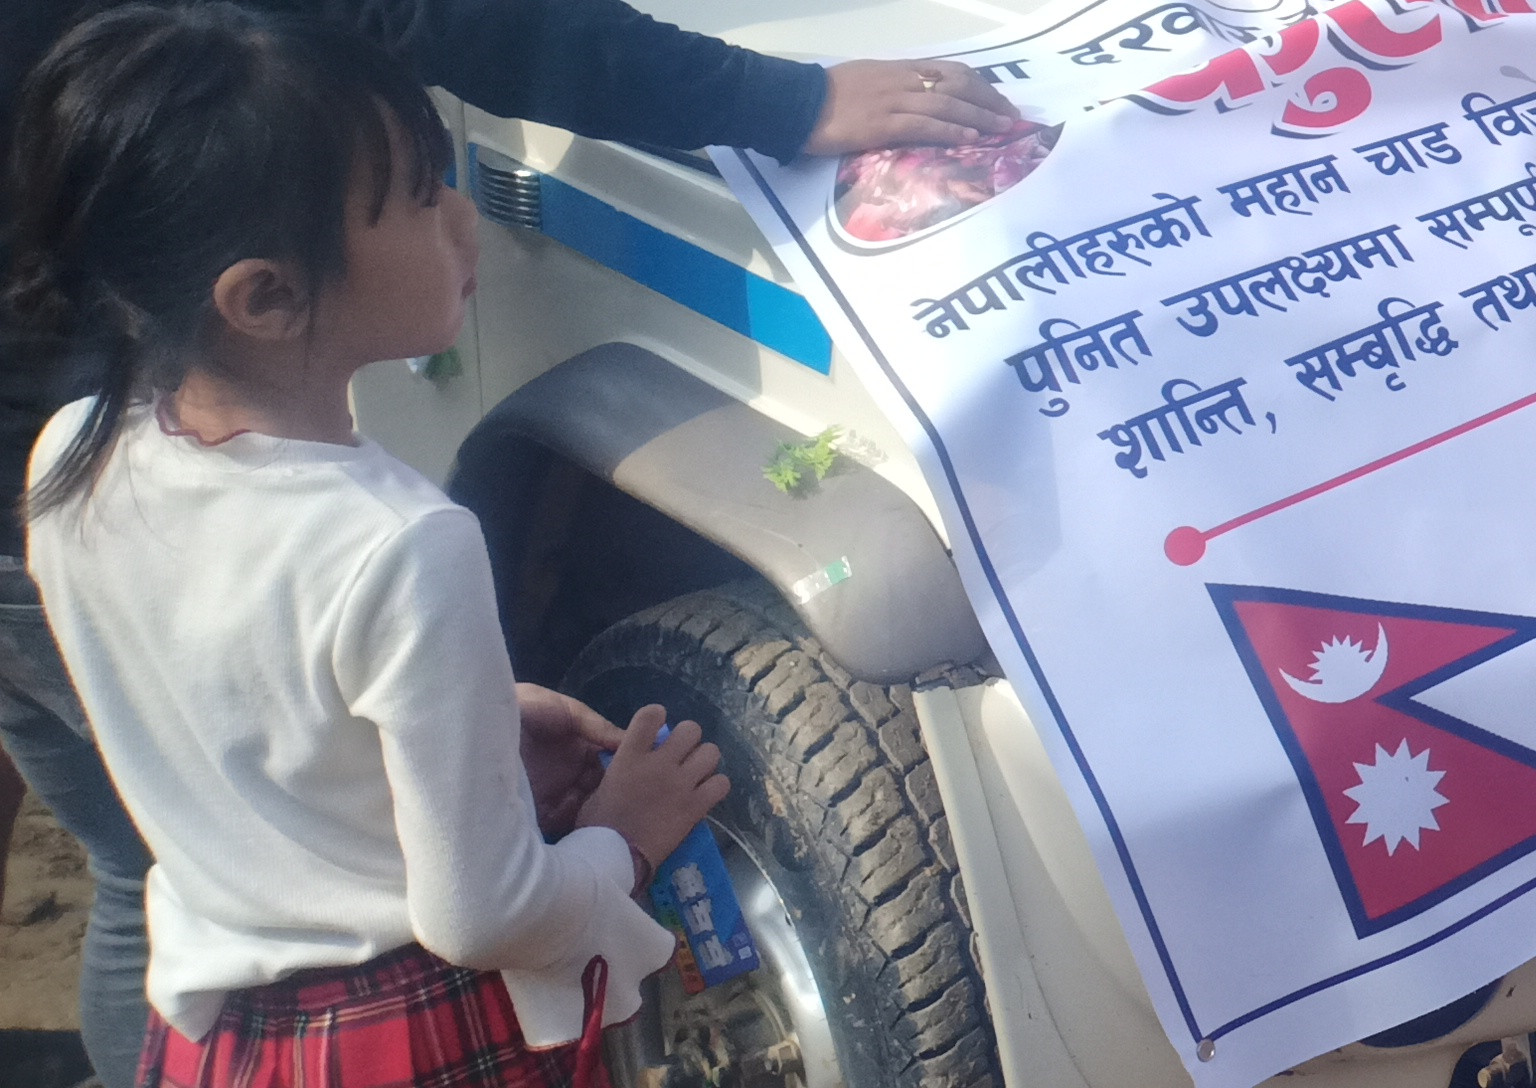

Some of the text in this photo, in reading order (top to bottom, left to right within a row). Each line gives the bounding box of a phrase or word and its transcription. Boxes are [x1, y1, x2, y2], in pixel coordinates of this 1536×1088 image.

[909, 192, 1212, 339] नेपालीहरुको
[1218, 154, 1351, 217] महान
[1354, 121, 1463, 176] चाड
[1004, 310, 1152, 417] पुनित
[1161, 224, 1415, 337] उपलक्ष्यमा
[1097, 376, 1277, 479] शान्ति,
